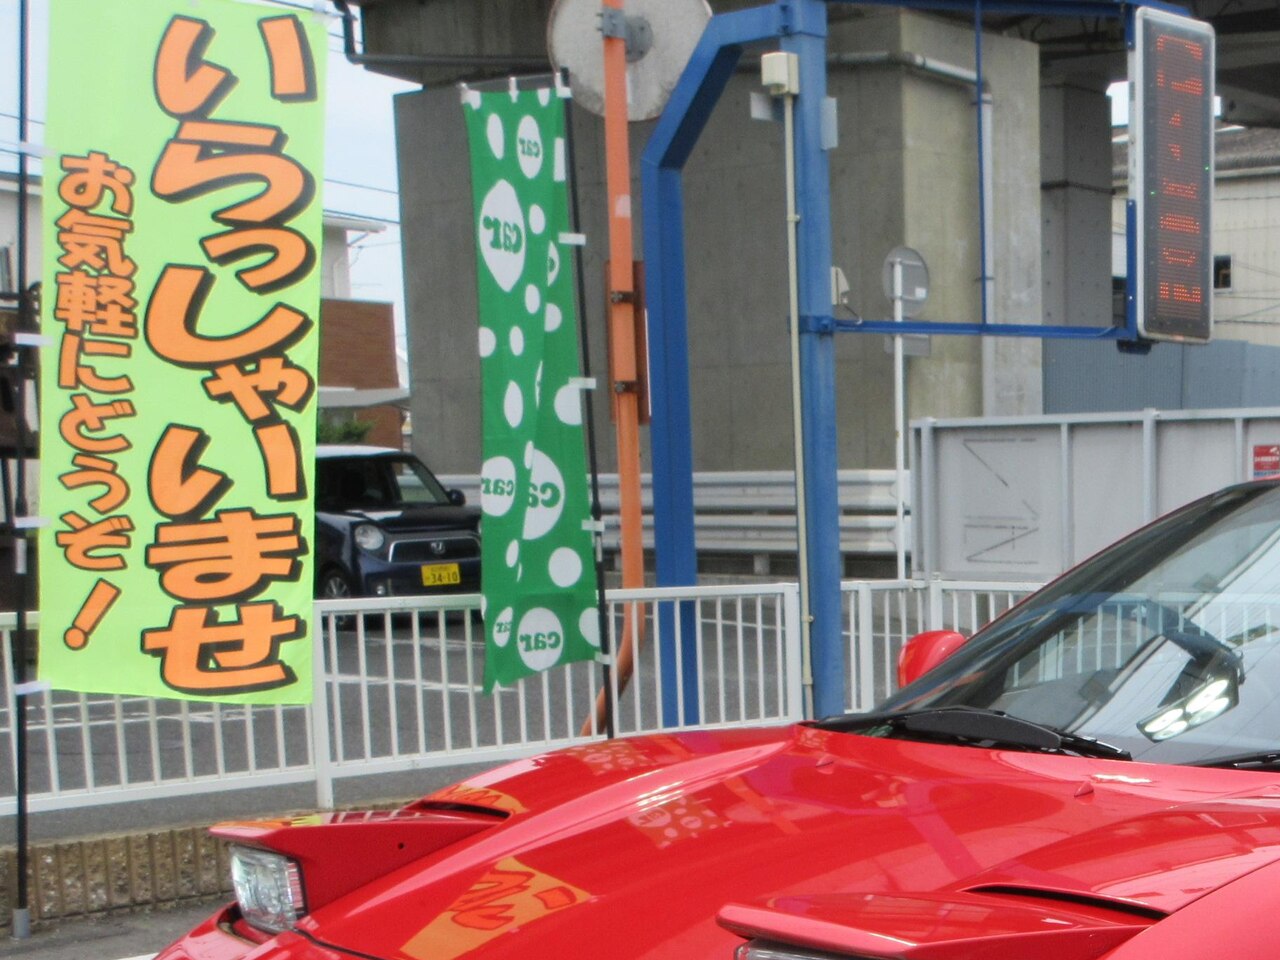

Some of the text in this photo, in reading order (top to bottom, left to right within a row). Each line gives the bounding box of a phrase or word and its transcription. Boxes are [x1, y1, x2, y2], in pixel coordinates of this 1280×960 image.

[141, 16, 317, 693] いらっしゃいませ
